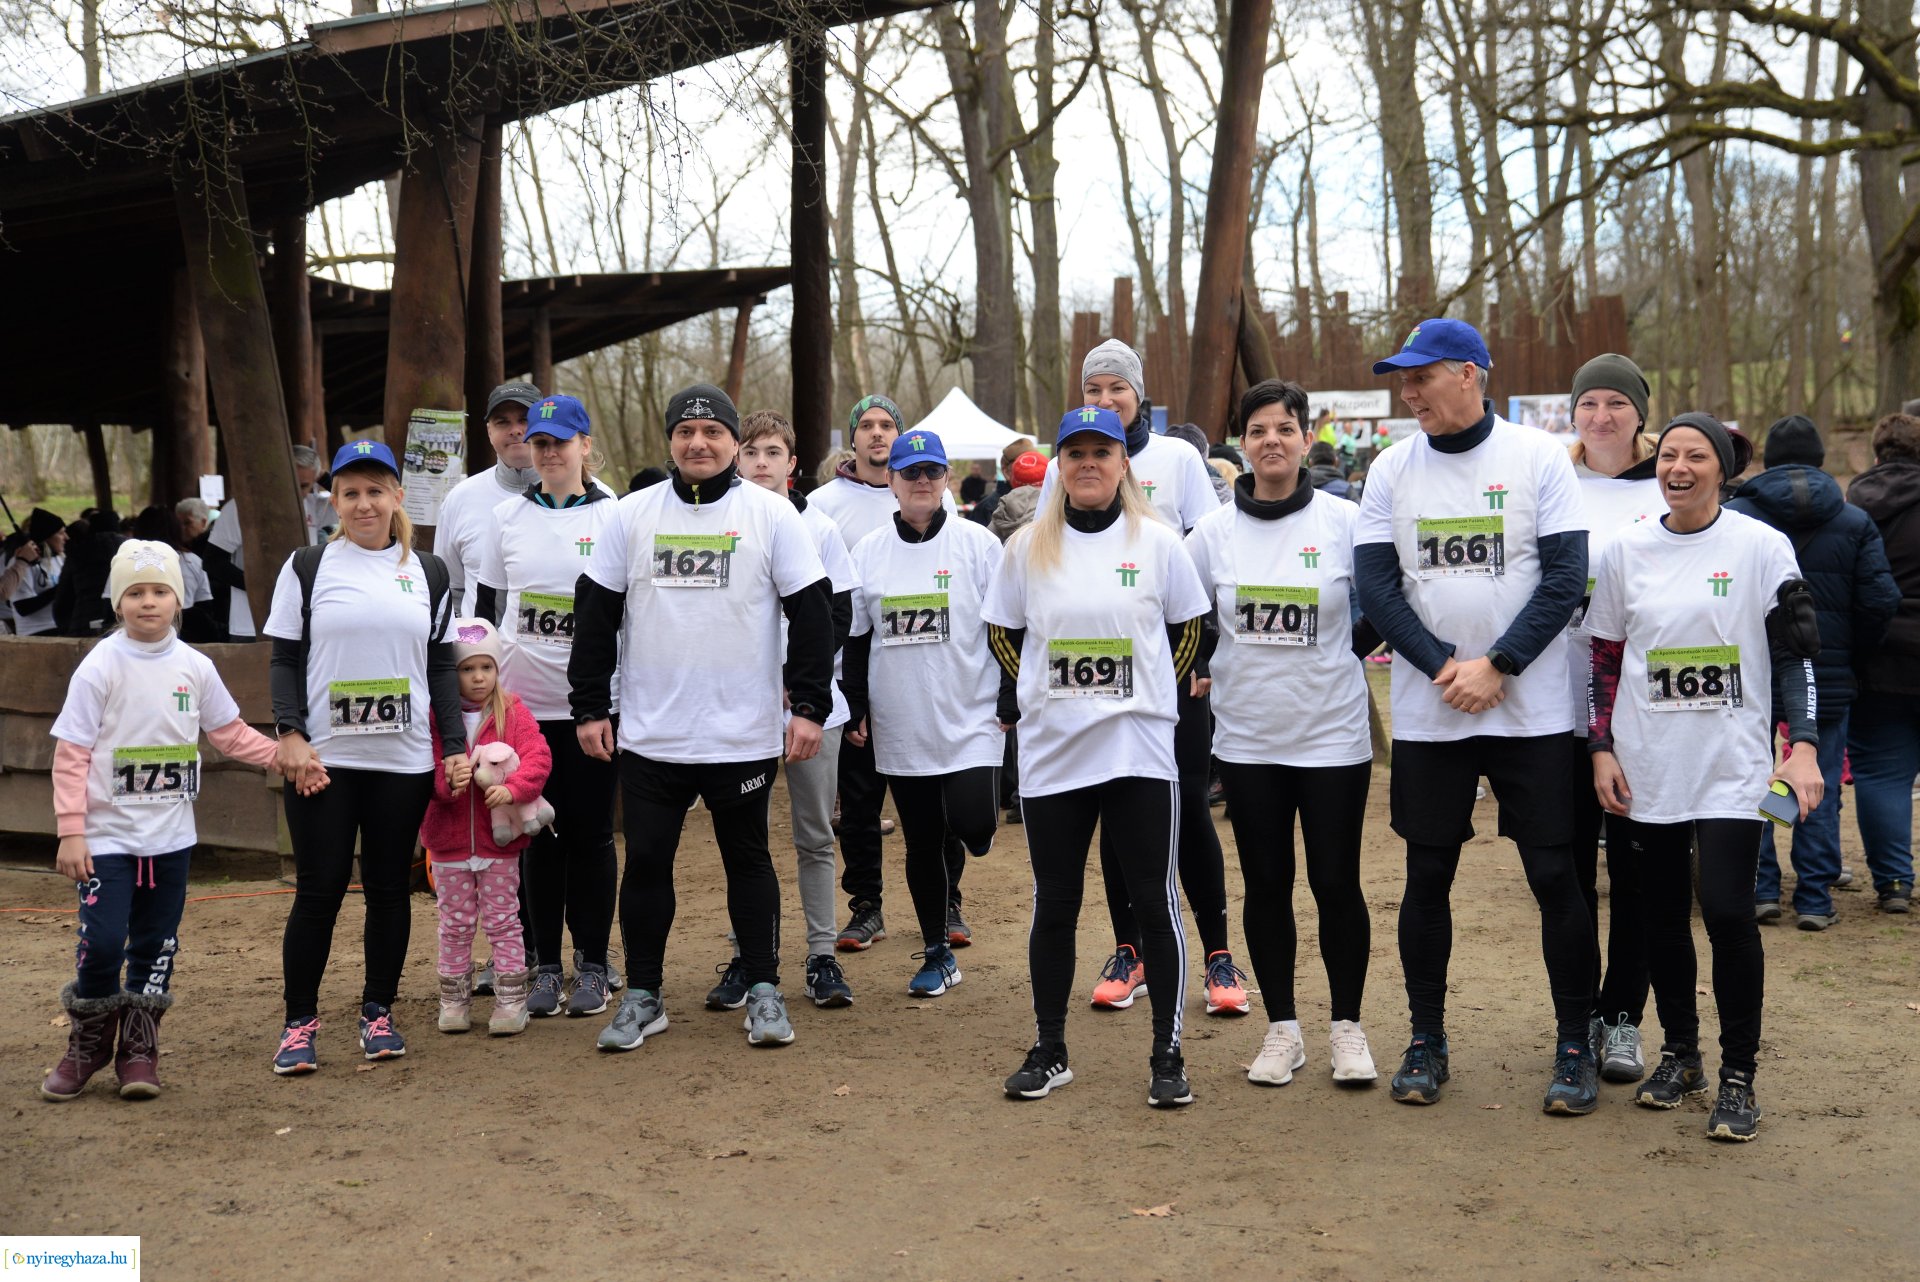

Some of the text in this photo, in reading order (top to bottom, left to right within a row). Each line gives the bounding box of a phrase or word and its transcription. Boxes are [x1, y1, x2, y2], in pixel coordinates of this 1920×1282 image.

[657, 549, 716, 576] 162
[1422, 534, 1488, 566] 166
[522, 607, 575, 637] 164
[884, 608, 937, 635] 172
[1239, 602, 1302, 632] 170
[1053, 656, 1116, 686] 169
[1652, 665, 1724, 698] 168
[334, 694, 397, 724] 176
[1806, 685, 1817, 721] NAKED
[118, 762, 182, 792] 175
[740, 772, 766, 794] ARMY
